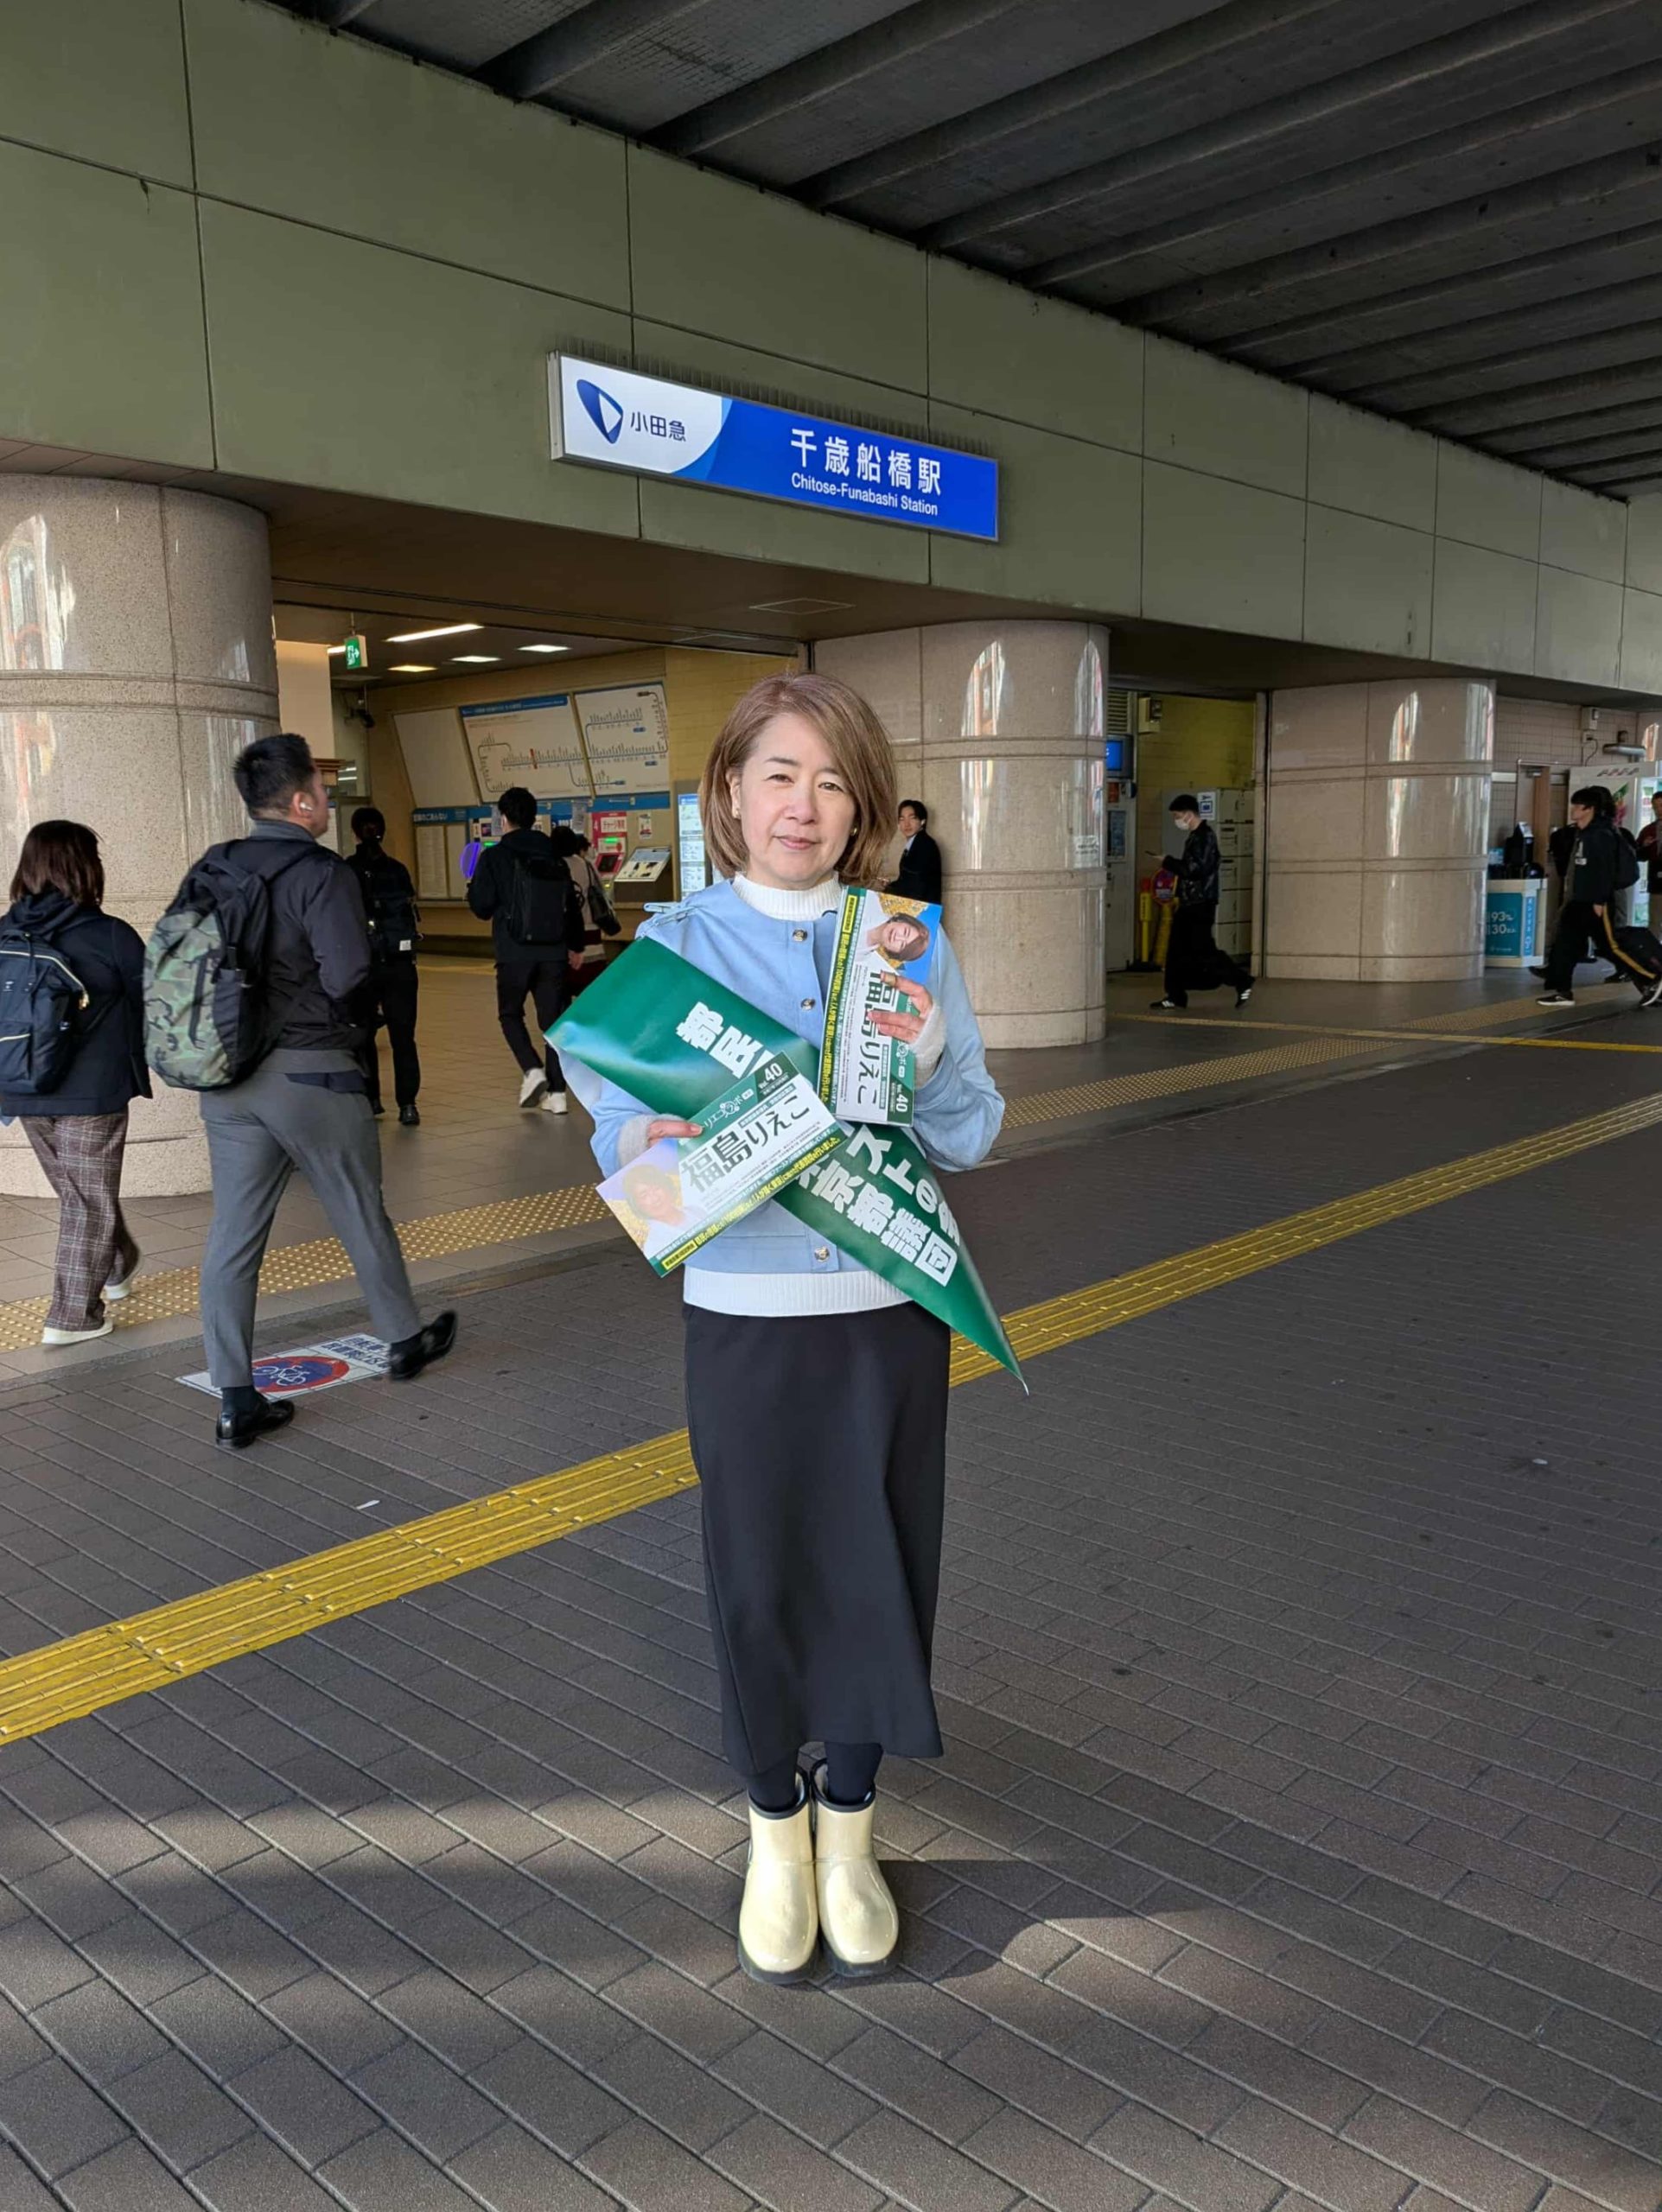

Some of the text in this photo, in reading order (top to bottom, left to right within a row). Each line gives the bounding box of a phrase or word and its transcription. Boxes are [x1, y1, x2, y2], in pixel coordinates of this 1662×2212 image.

[630, 411, 686, 442] 小田急
[791, 429, 940, 496] 千歳船橋駅
[792, 472, 939, 516] Chitose-Funabashi Station
[681, 1095, 810, 1192] 福島りえこ
